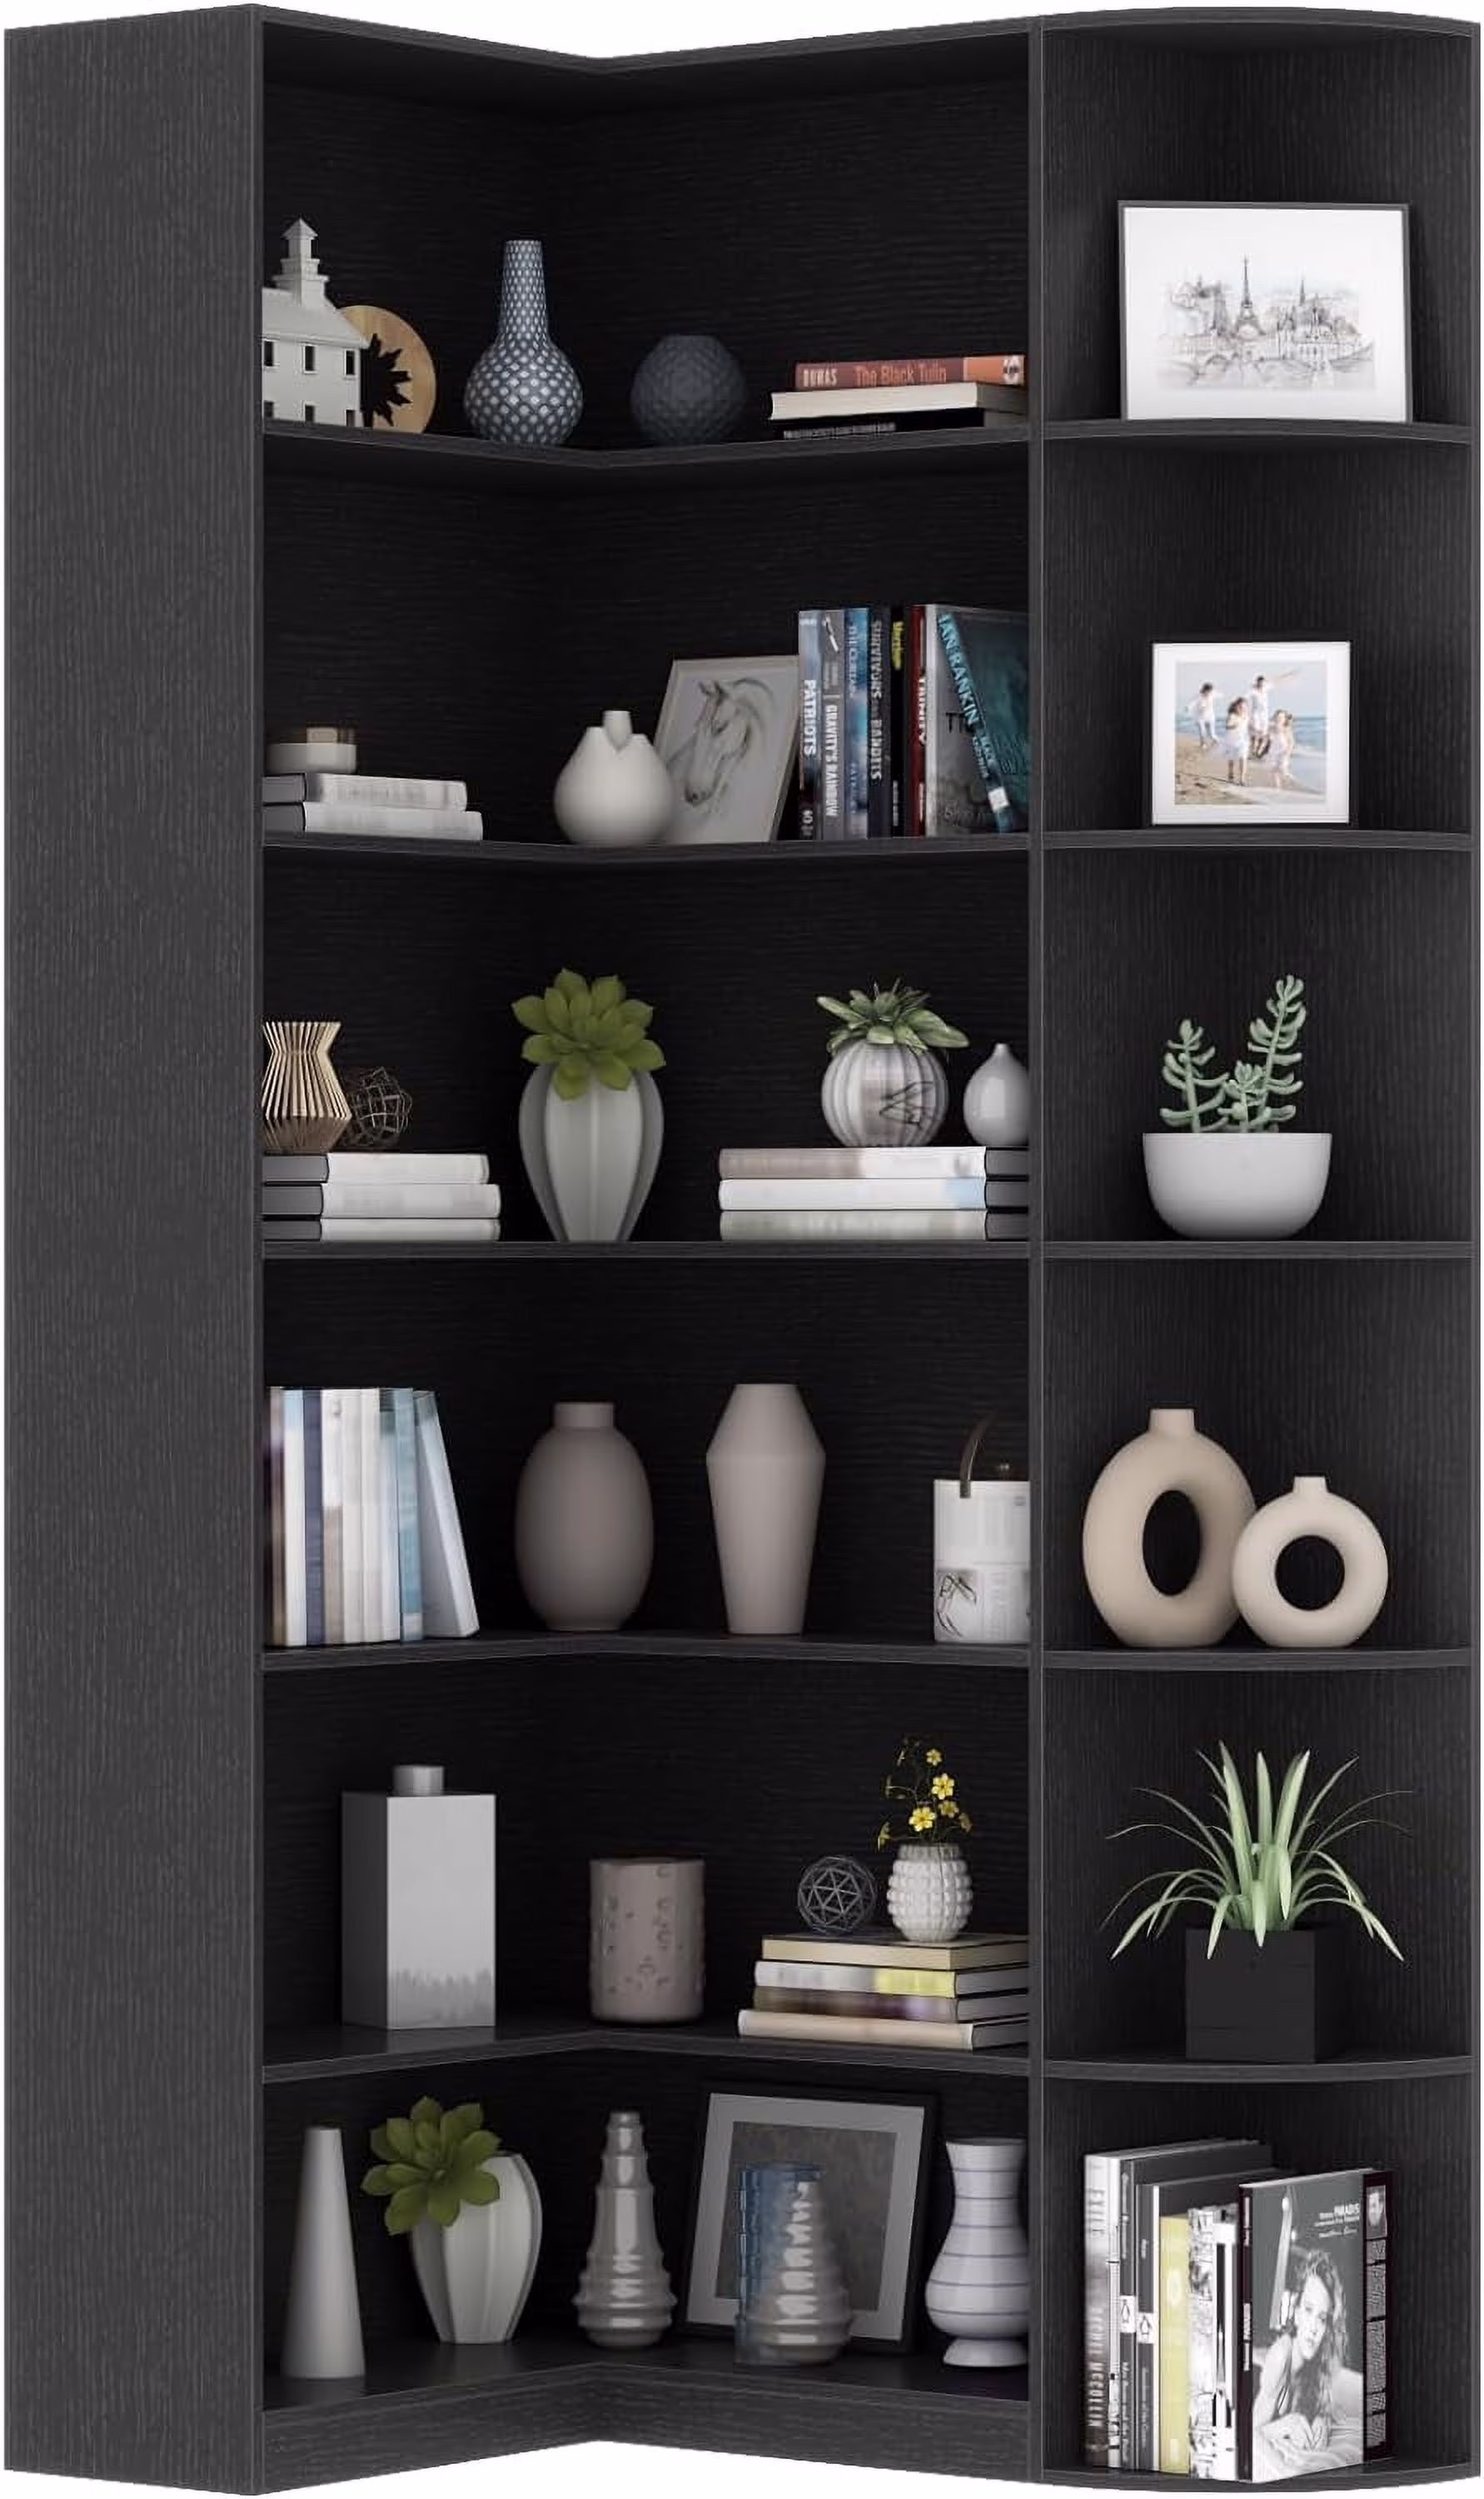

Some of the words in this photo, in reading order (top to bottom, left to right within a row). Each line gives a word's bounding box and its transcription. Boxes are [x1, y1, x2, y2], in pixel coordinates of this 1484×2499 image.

[871, 621, 882, 698] SURVIVORS
[938, 612, 957, 650] IAN
[949, 650, 980, 726] RANKIN
[803, 679, 817, 757] PATRIOTS
[825, 705, 838, 761] GRAVITY'S
[871, 719, 882, 780] BANDITS
